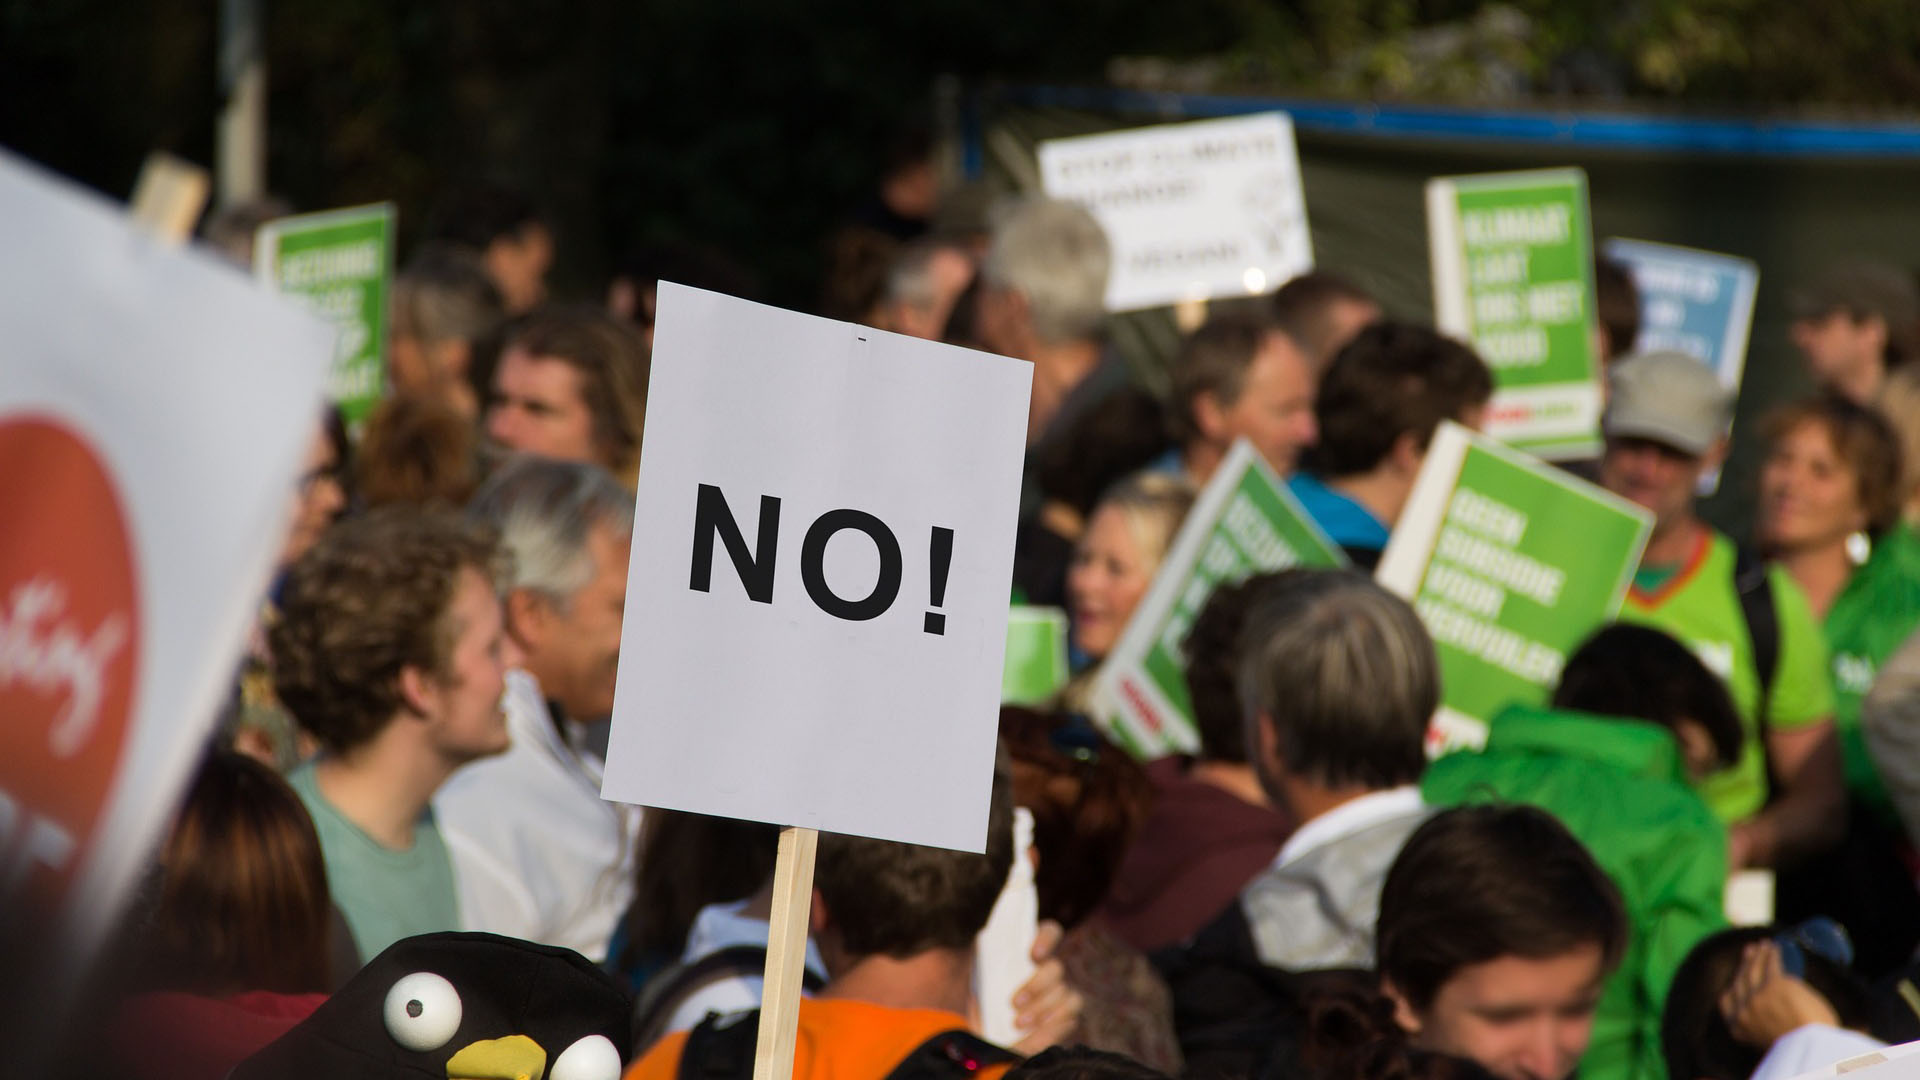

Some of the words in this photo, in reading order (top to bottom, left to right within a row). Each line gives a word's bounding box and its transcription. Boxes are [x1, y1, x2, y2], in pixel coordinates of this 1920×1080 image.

[1462, 201, 1571, 249] KLIMAAT
[1454, 486, 1529, 548] GEEN
[689, 483, 954, 636] NO!
[1424, 560, 1506, 620] VOOR
[1438, 526, 1567, 607] SUBSIDIE
